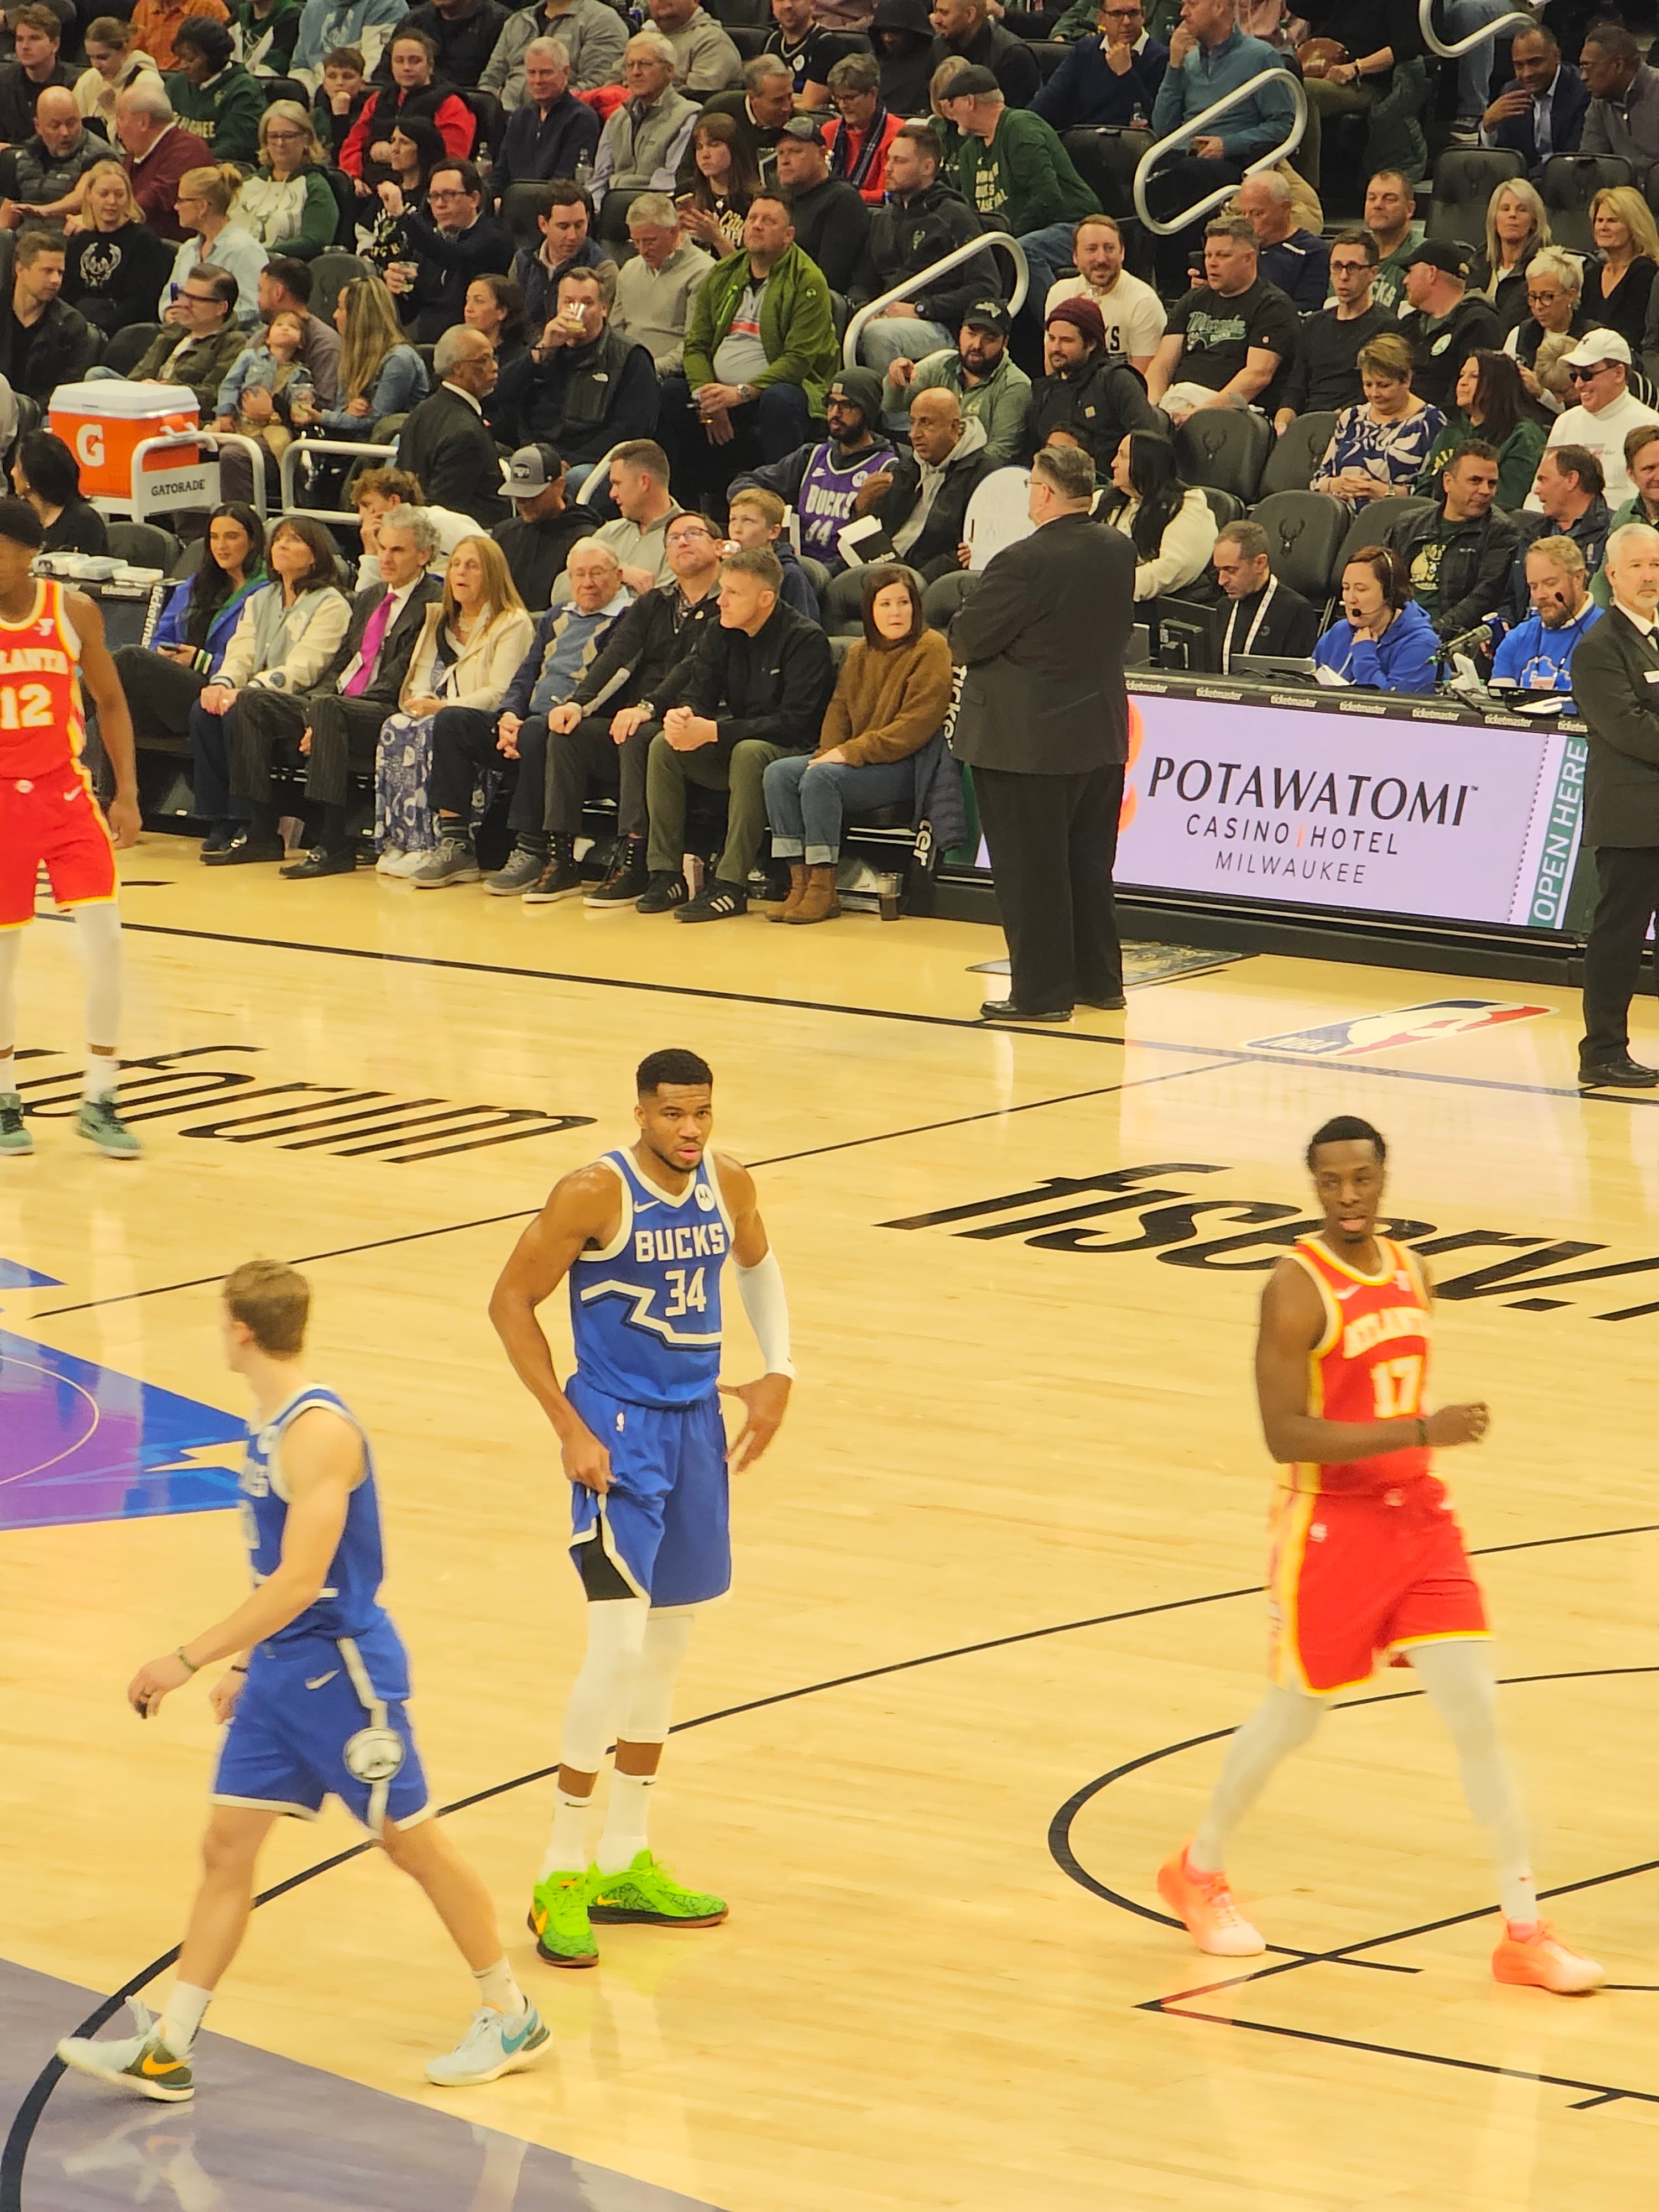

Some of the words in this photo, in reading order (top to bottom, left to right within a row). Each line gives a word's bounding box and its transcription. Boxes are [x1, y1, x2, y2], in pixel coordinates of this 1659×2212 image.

[1368, 281, 1397, 307] CKS
[77, 423, 105, 467] G
[151, 479, 205, 497] GATORADE
[0, 648, 69, 675] LANTA
[1, 684, 55, 729] 12
[1196, 687, 1243, 700] ticketmaster
[1271, 694, 1317, 708] ticketmaster
[1339, 701, 1387, 714] ticketmaster
[1412, 707, 1460, 721] ticketmaster
[1485, 714, 1533, 727] ticketmaster
[1557, 720, 1588, 733] ticketm
[1186, 813, 1289, 844] CASINO
[1310, 825, 1397, 855] HOTEL
[1533, 833, 1570, 922] OPEN
[1553, 740, 1589, 828] HERE
[1215, 851, 1366, 884] MILWAUKEE
[634, 1222, 724, 1263] BUCKS
[665, 1267, 707, 1317] 34
[1370, 1354, 1423, 1419] 17
